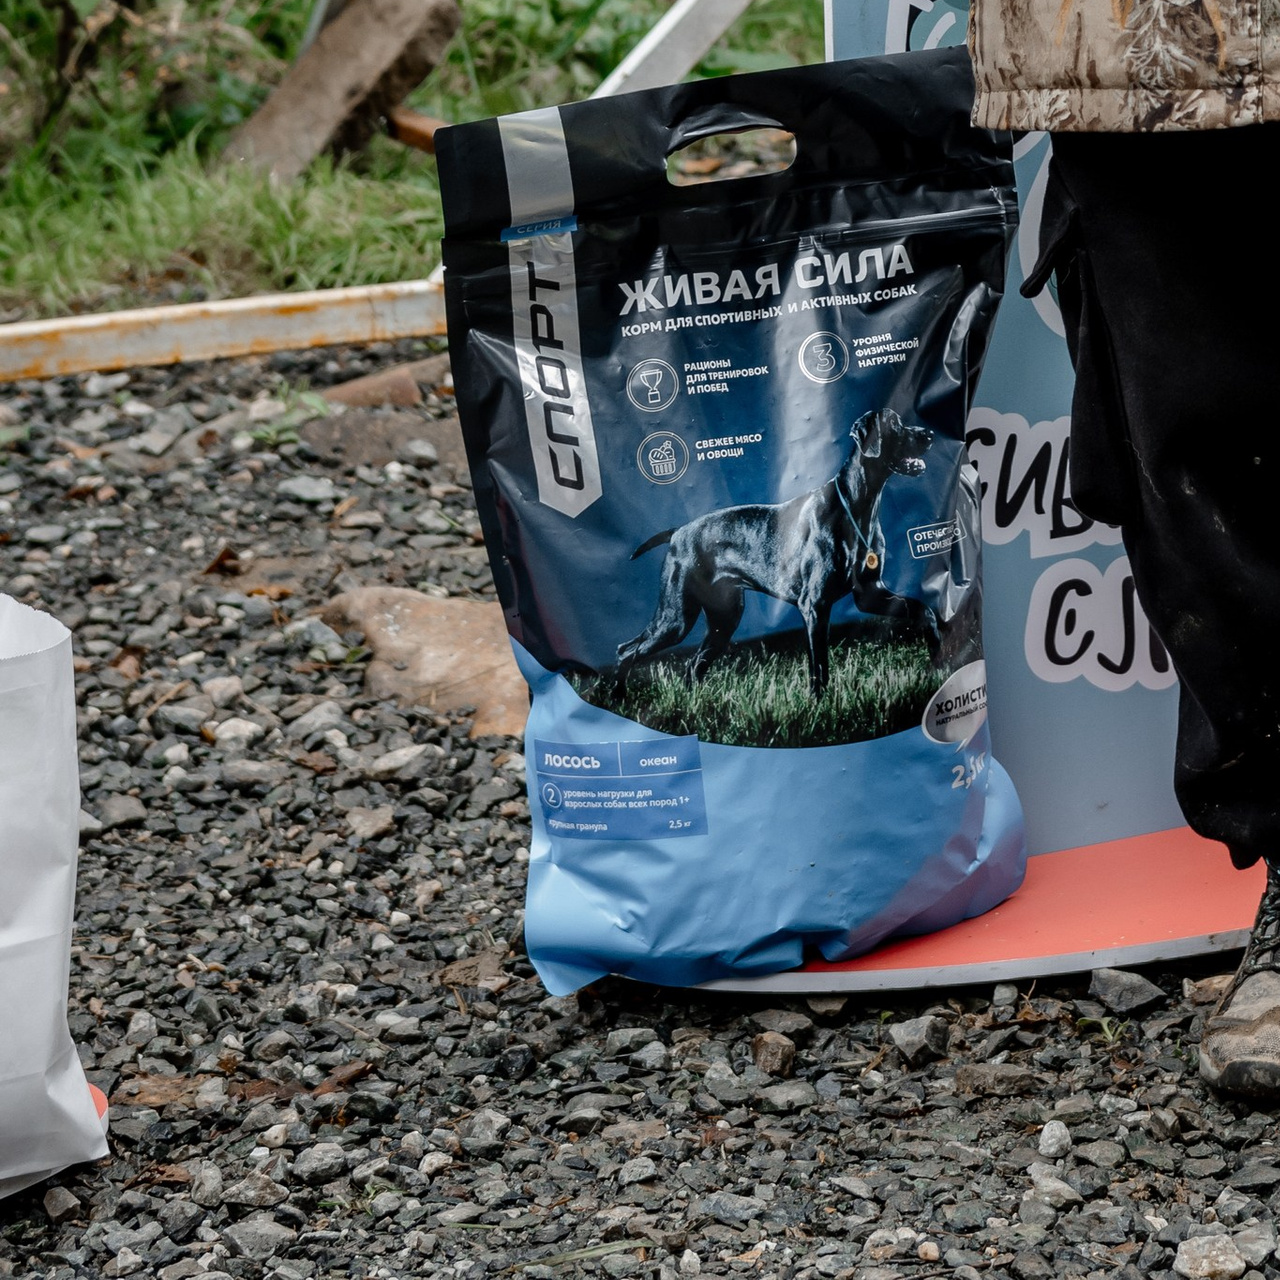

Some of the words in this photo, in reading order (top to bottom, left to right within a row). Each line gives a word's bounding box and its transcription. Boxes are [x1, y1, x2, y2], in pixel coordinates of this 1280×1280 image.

[618, 263, 781, 316] ЖИВАЯ
[794, 244, 914, 289] СИЛА
[621, 321, 662, 337] КОРМ
[664, 317, 693, 333] ДЛЯ
[695, 306, 783, 327] СПОРТИВНЫХ
[788, 302, 798, 313] И
[801, 292, 873, 311] АКТИВНЫХ
[874, 284, 918, 302] СОБАК
[852, 332, 892, 347] УРОВНЯ
[855, 338, 919, 358] ФИЗИЧЕСКОЙ
[812, 343, 836, 372] 3
[858, 353, 906, 368] НАГРУЗКИ
[684, 359, 731, 372] РАЦИОНЫ
[527, 261, 585, 491] СПОРТ
[686, 373, 707, 385] ДЛЯ
[708, 366, 769, 380] ТРЕНИРОВОК
[687, 386, 695, 395] И
[697, 383, 729, 394] ПОБЕД
[695, 436, 734, 449] СВЕЖЕЕ
[735, 433, 762, 444] МЯСО
[697, 452, 705, 461] И
[706, 448, 744, 460] ОВОЩИ
[640, 756, 677, 767] океан
[548, 789, 556, 803] 2
[564, 790, 596, 798] уровень
[598, 790, 635, 800] нагрузки
[637, 789, 653, 798] для
[604, 800, 627, 808] собак
[650, 799, 677, 808] пород
